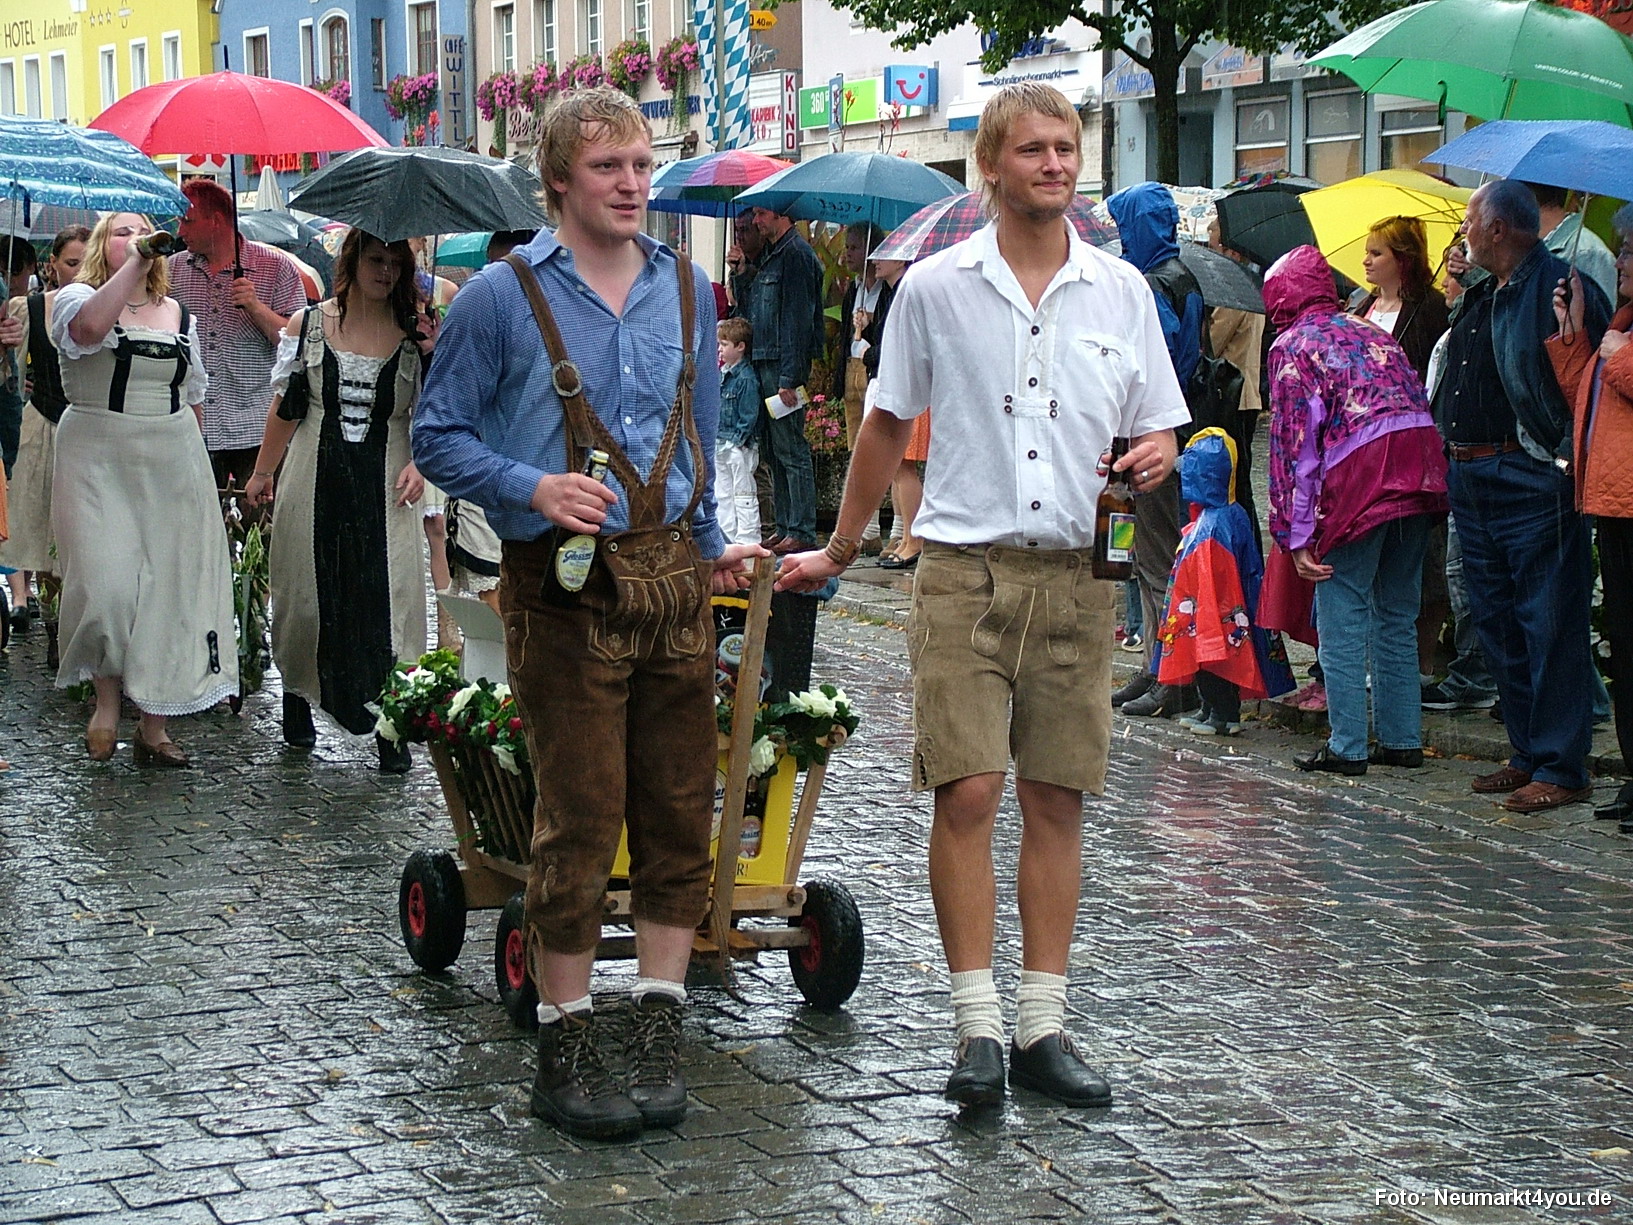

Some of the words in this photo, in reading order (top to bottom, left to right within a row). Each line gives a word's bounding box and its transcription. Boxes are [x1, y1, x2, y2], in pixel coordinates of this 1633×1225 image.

[4, 20, 36, 48] HOTEL
[43, 16, 78, 40] Lehmeier
[785, 74, 795, 149] KINO
